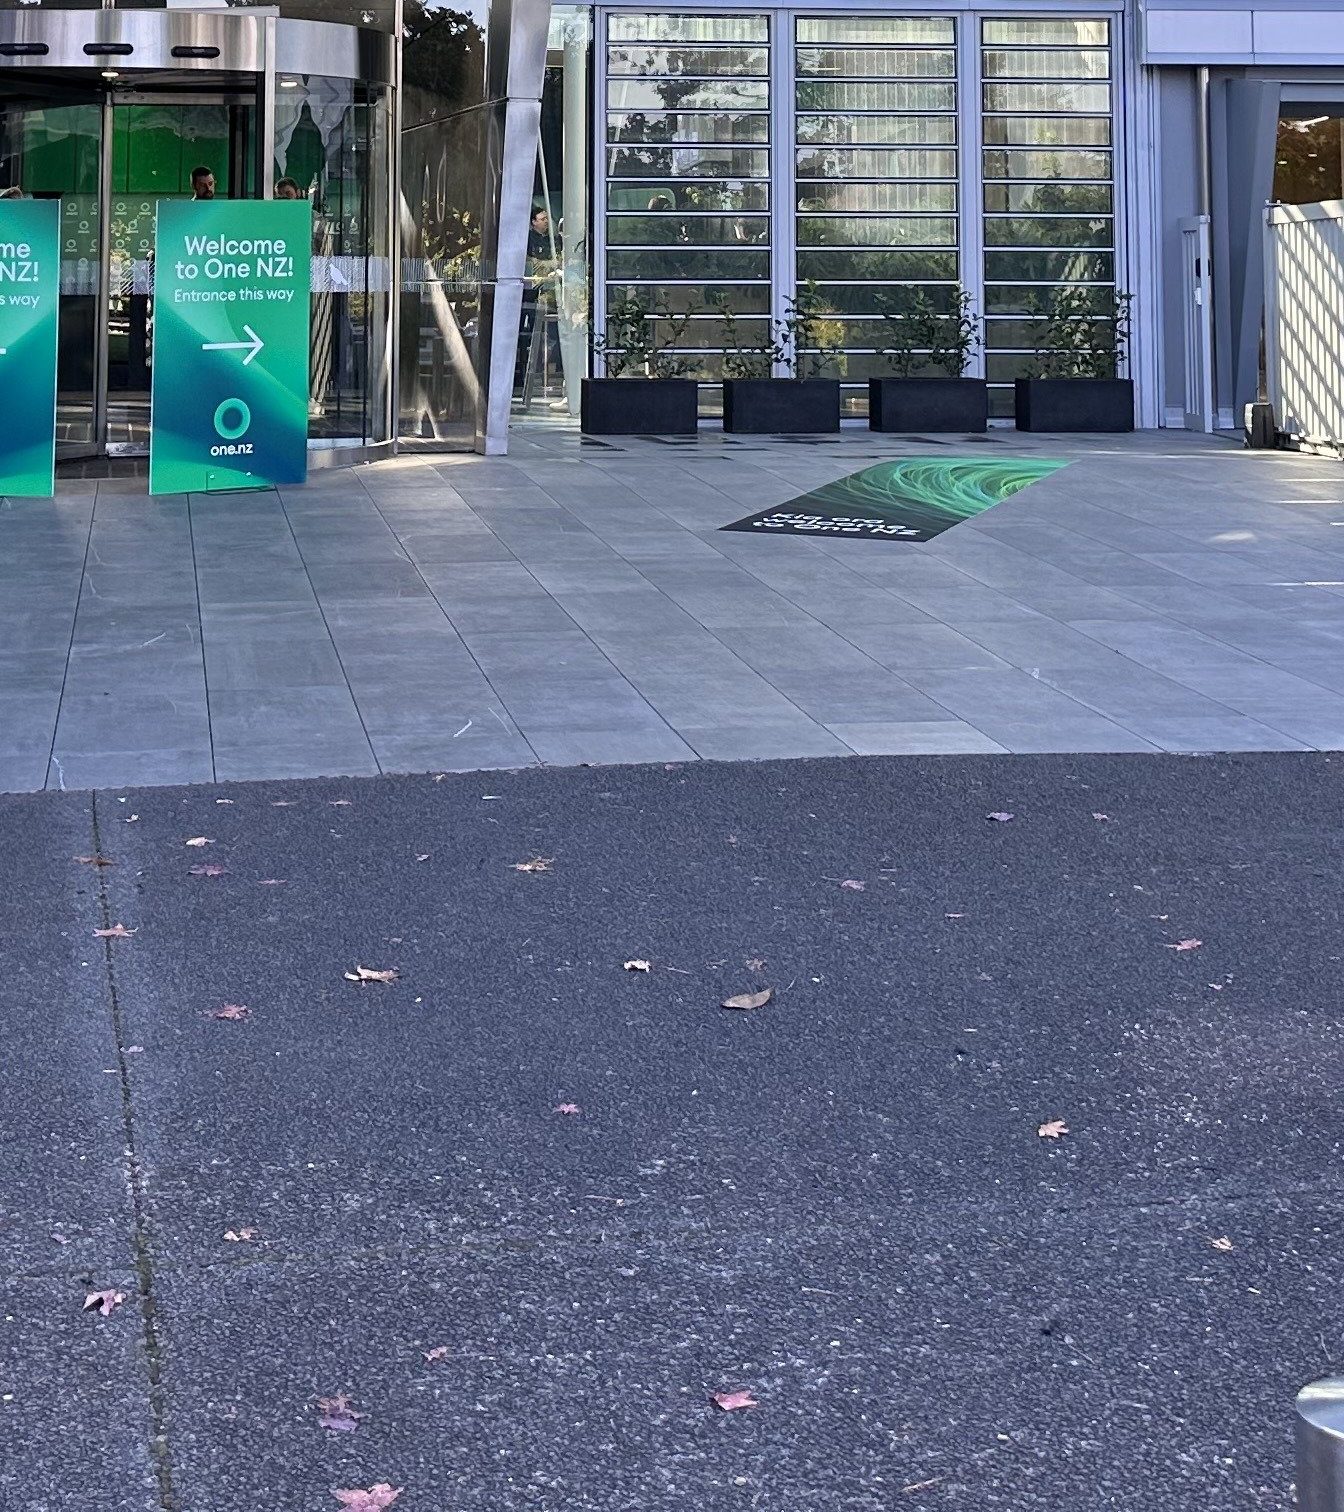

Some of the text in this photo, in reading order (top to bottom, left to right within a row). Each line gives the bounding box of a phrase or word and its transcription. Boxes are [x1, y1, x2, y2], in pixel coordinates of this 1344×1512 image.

[184, 233, 286, 256] Welcome
[174, 256, 294, 279] to One NZ!
[8, 294, 41, 309] way
[174, 286, 295, 303] Entrance this way
[210, 443, 254, 457] one.nz
